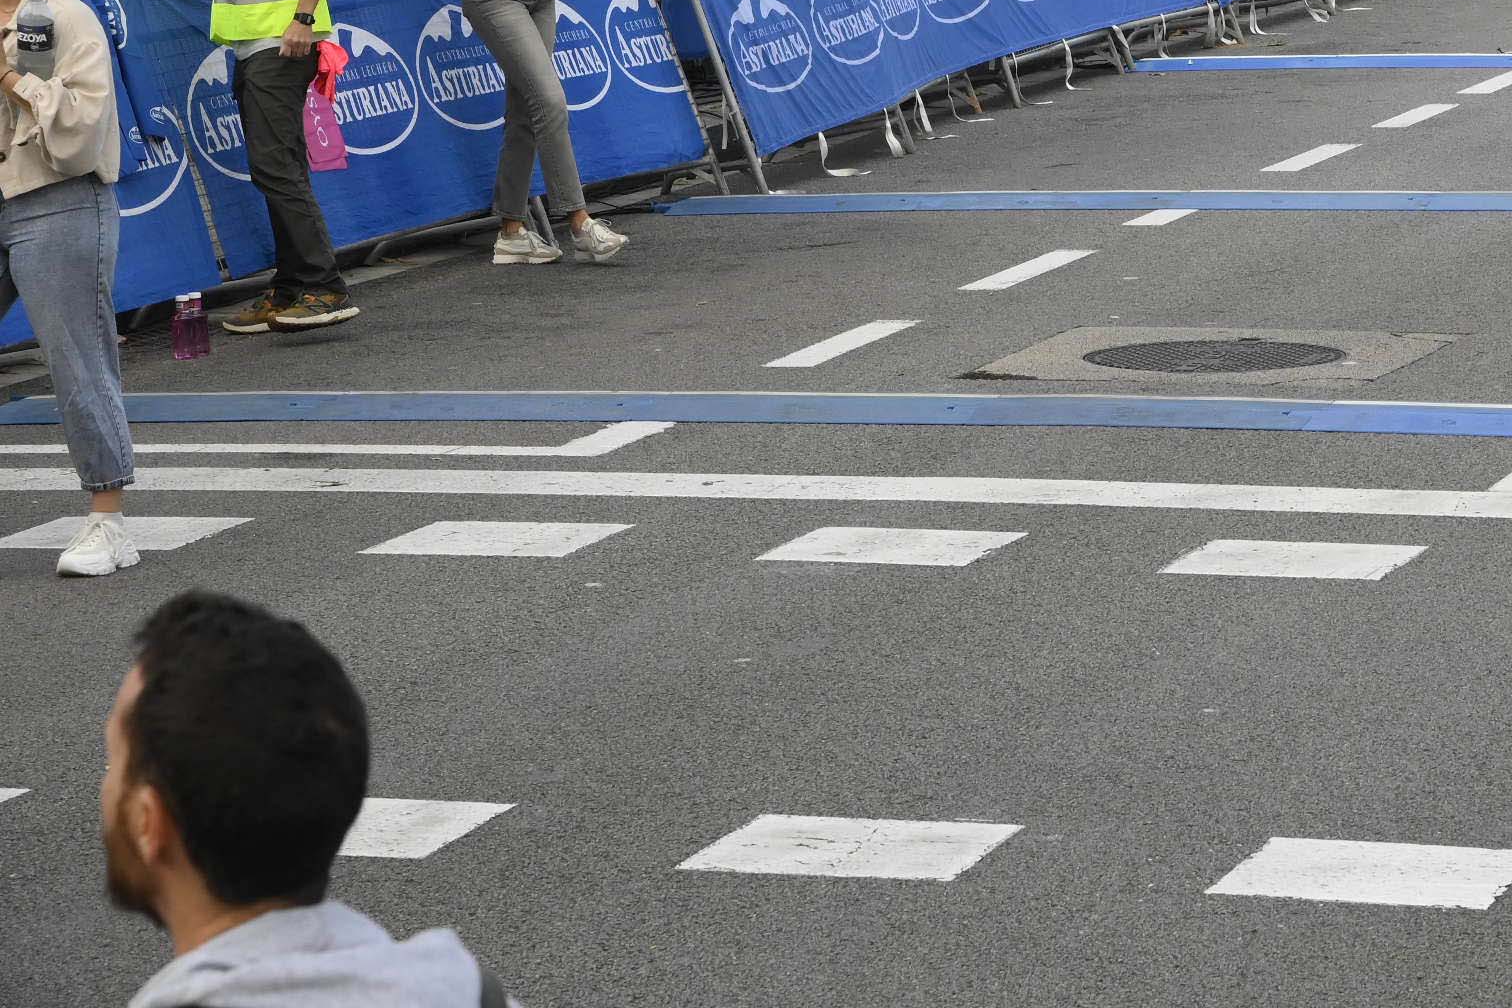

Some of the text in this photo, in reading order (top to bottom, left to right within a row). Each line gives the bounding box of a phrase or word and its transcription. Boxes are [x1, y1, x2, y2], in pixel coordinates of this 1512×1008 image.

[17, 31, 47, 43] EZOYA
[436, 47, 467, 63] CENTRAL
[551, 44, 607, 81] URIANA
[336, 60, 398, 84] NTRAL LECHERA
[427, 55, 506, 104] ASTURIAN
[332, 78, 414, 126] STURIANA
